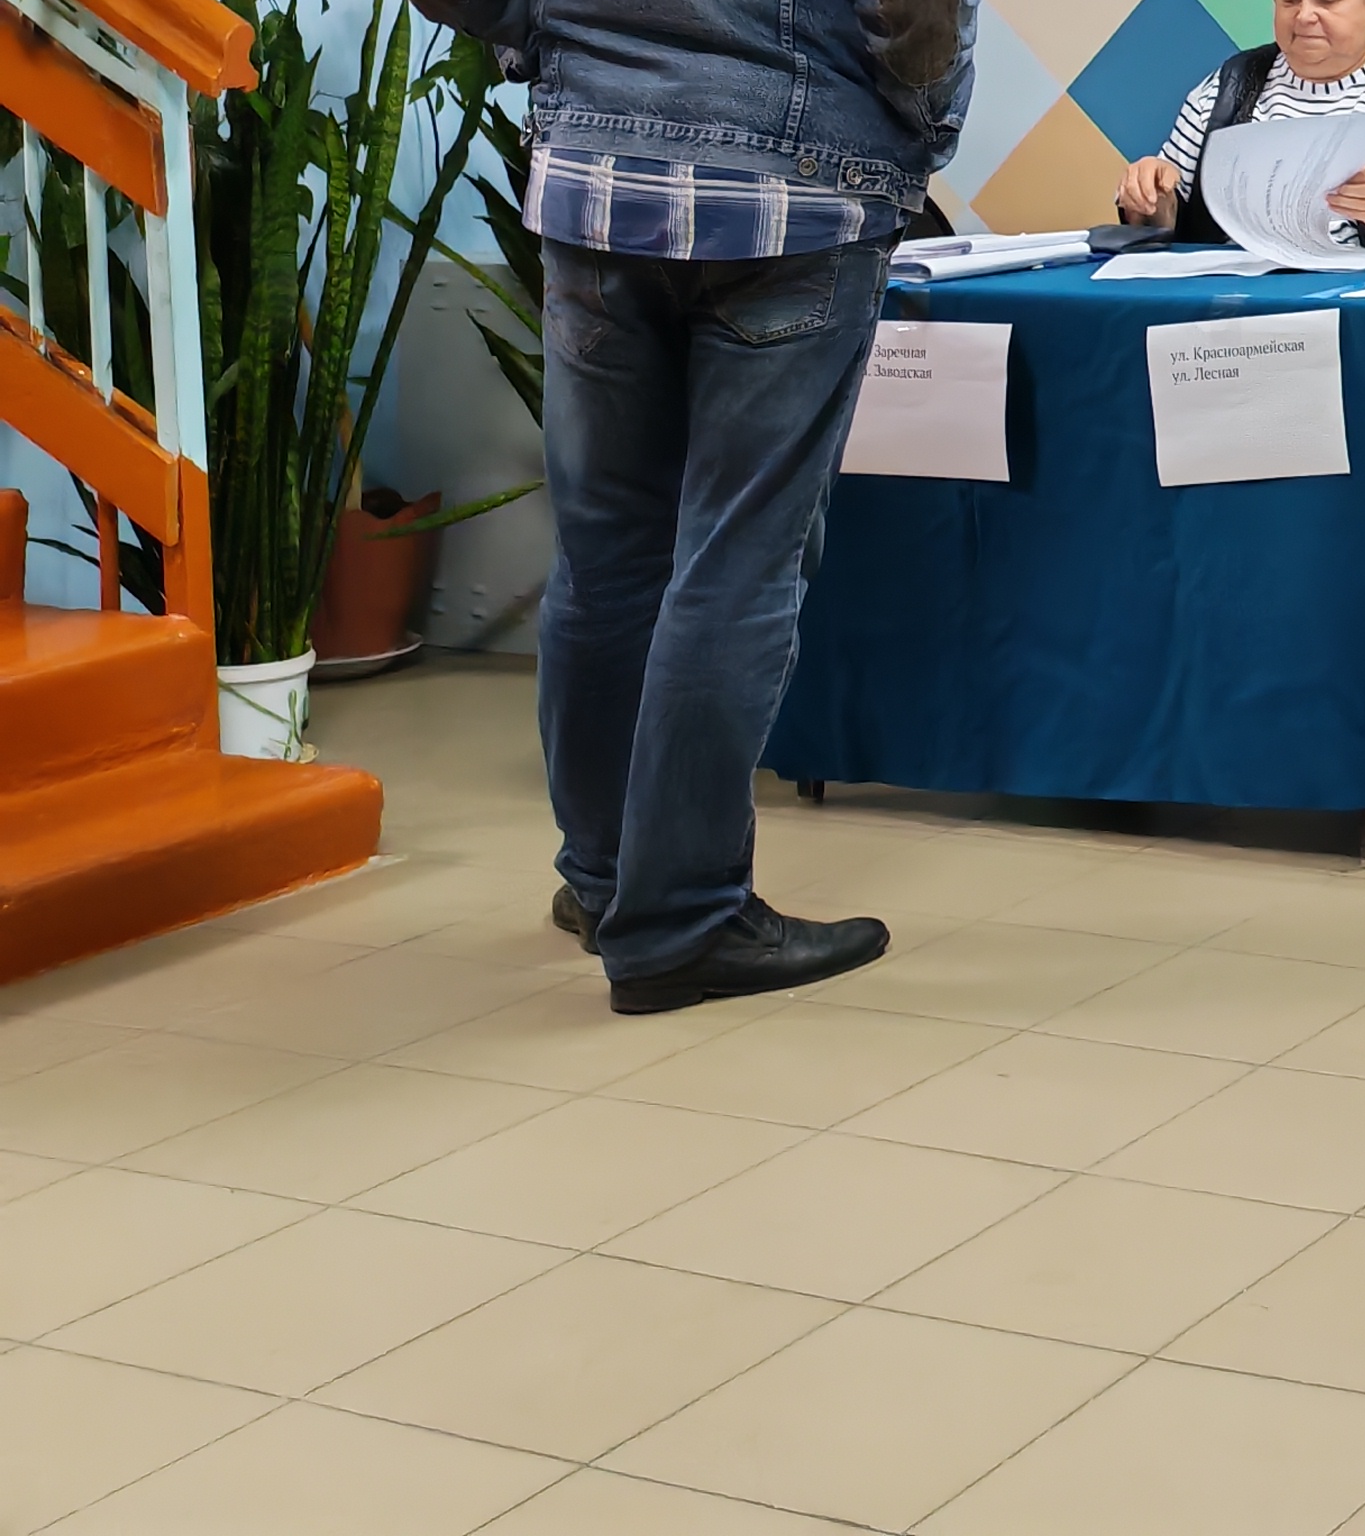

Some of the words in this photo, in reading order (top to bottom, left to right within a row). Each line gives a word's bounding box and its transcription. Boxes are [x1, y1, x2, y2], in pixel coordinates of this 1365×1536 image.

[874, 344, 927, 361] Заречная
[1170, 352, 1190, 365] ул.
[1193, 339, 1305, 362] Красноармейская
[874, 364, 932, 380] Заводская
[1172, 372, 1192, 387] ул.
[1195, 365, 1240, 381] Лесная
